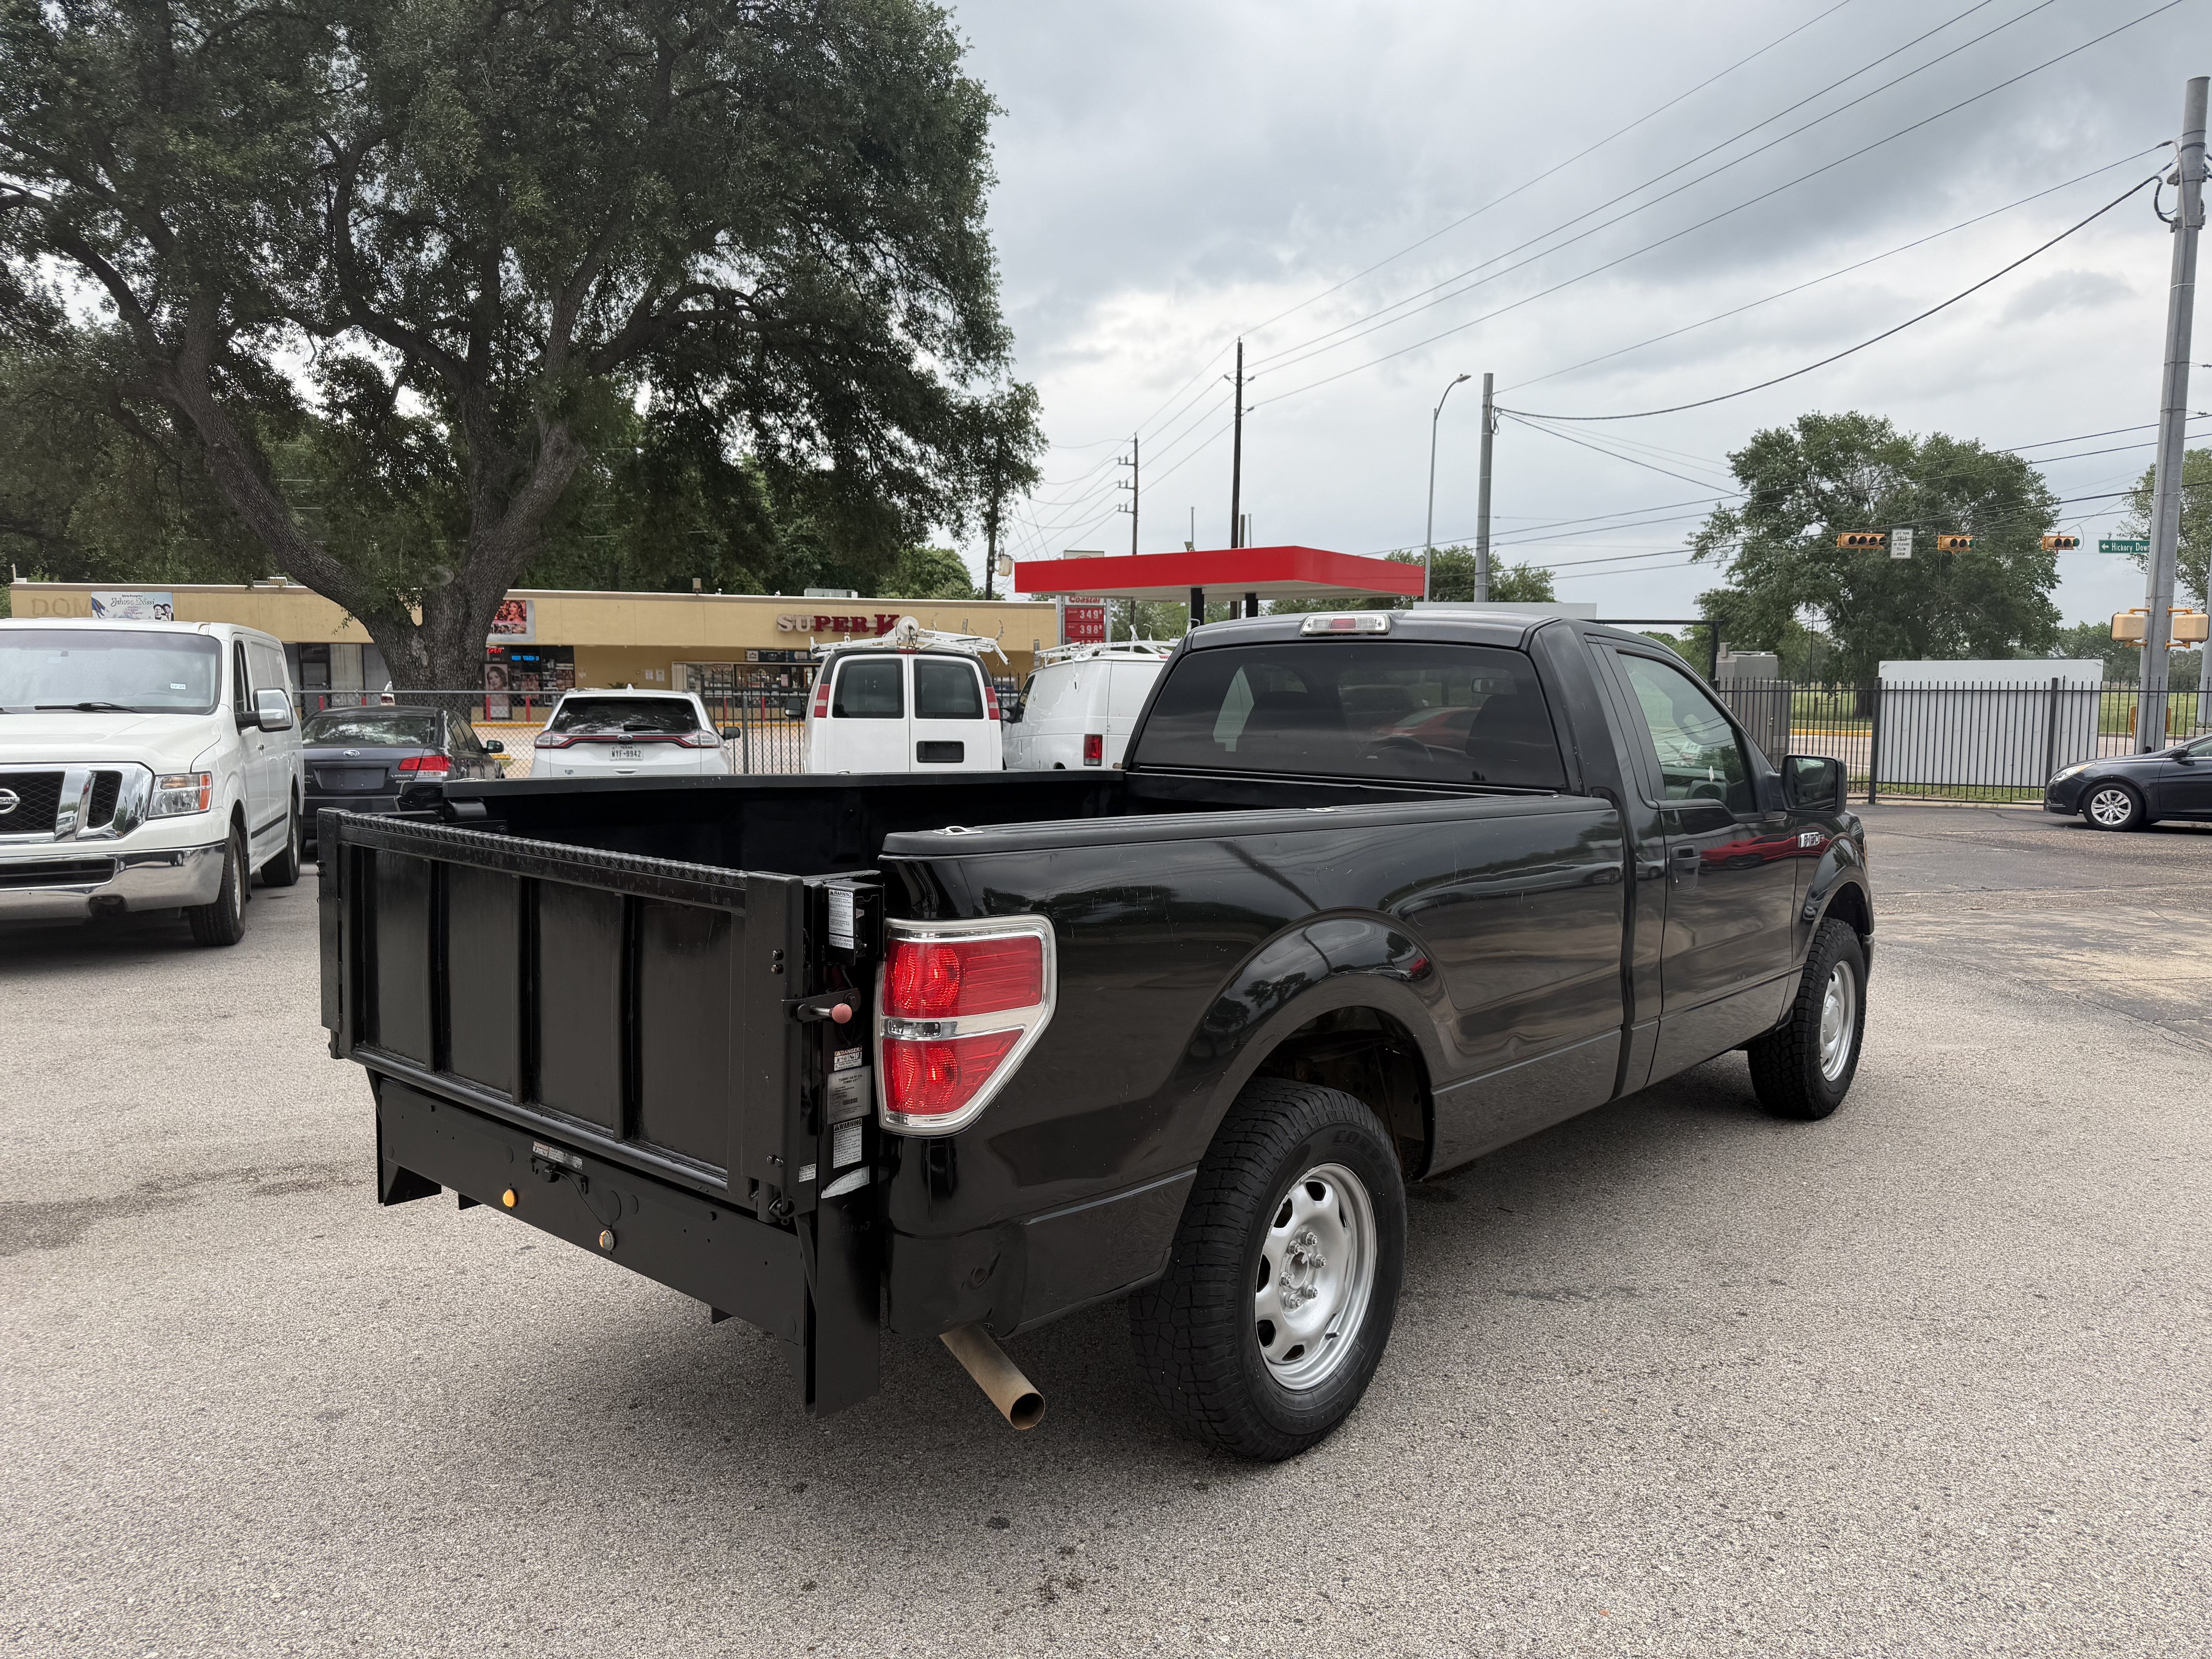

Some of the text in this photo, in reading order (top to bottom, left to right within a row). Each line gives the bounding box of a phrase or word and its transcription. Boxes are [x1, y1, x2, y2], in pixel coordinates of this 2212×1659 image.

[2112, 542, 2133, 552] Hickory
[777, 613, 900, 635] SUPER K
[841, 1047, 860, 1055] DANGER
[840, 1118, 862, 1130] WARNING
[799, 1164, 815, 1172] AUTION
